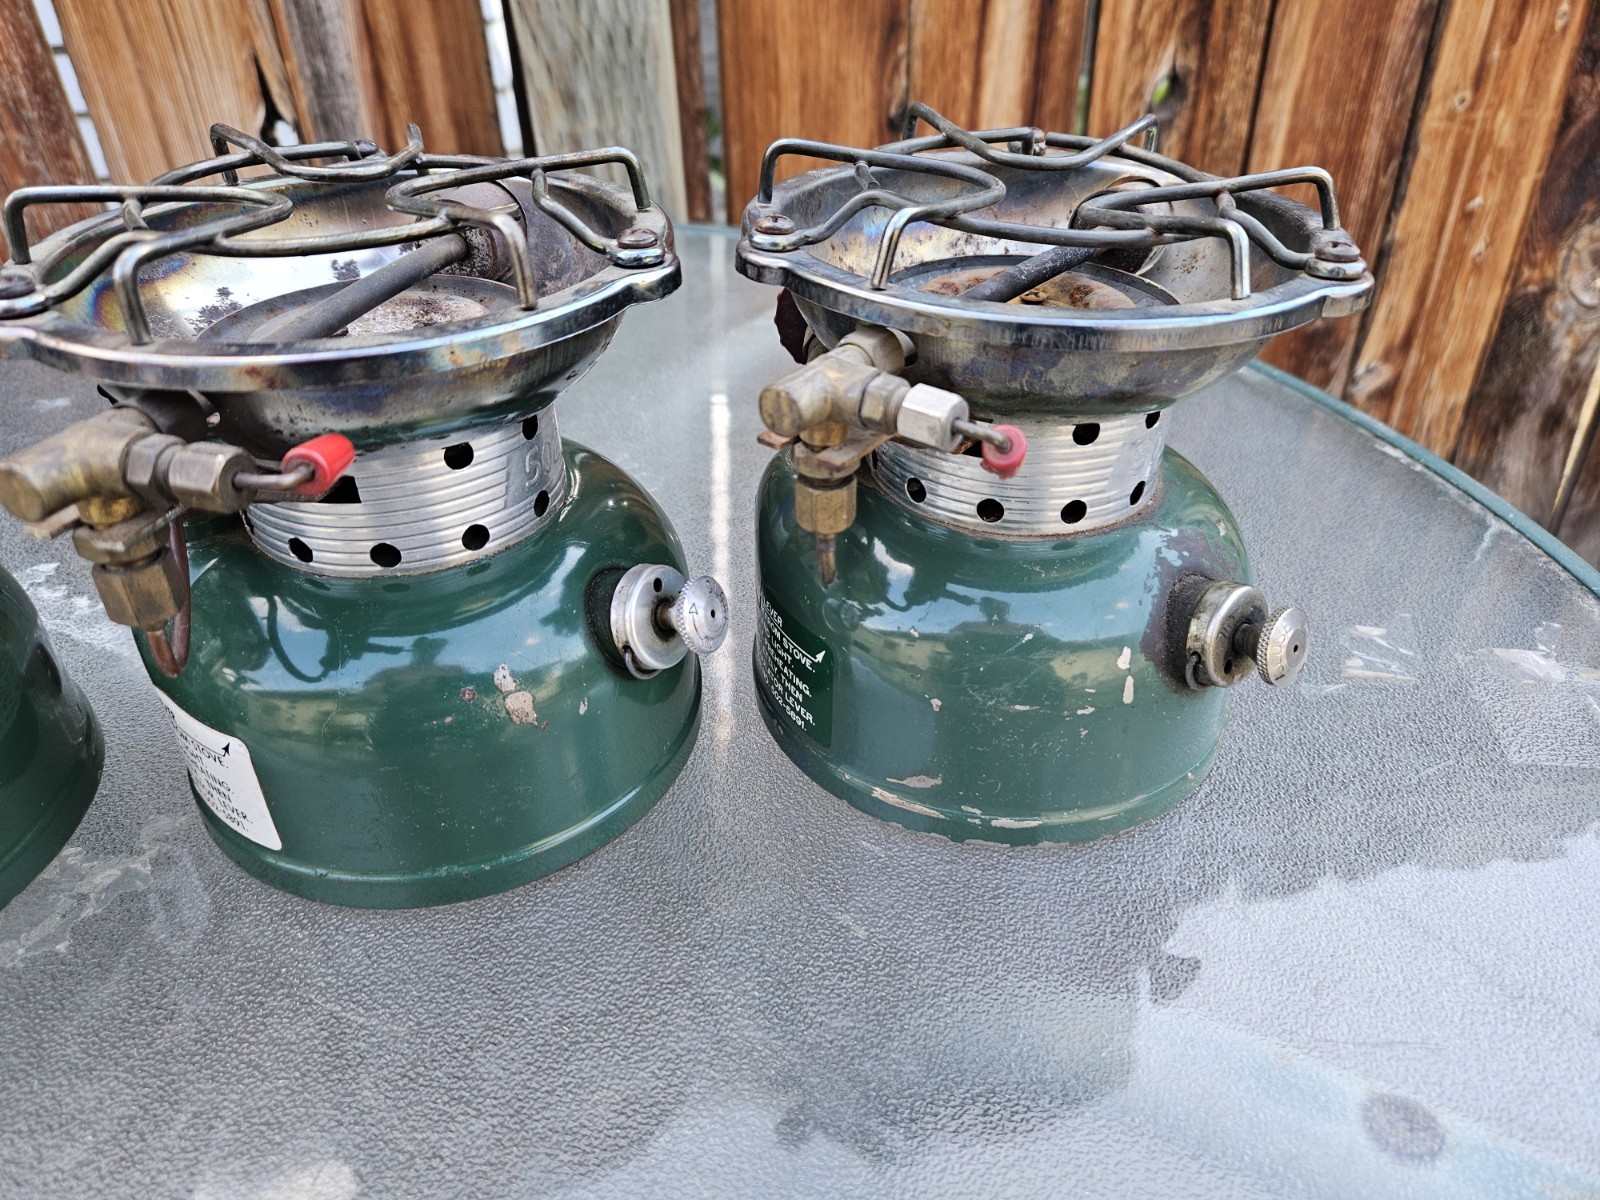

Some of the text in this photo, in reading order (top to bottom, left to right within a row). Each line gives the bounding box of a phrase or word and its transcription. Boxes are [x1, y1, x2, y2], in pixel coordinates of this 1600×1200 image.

[782, 637, 816, 673] STOVE.
[780, 673, 803, 703] THEN
[784, 691, 816, 726] LEVER.
